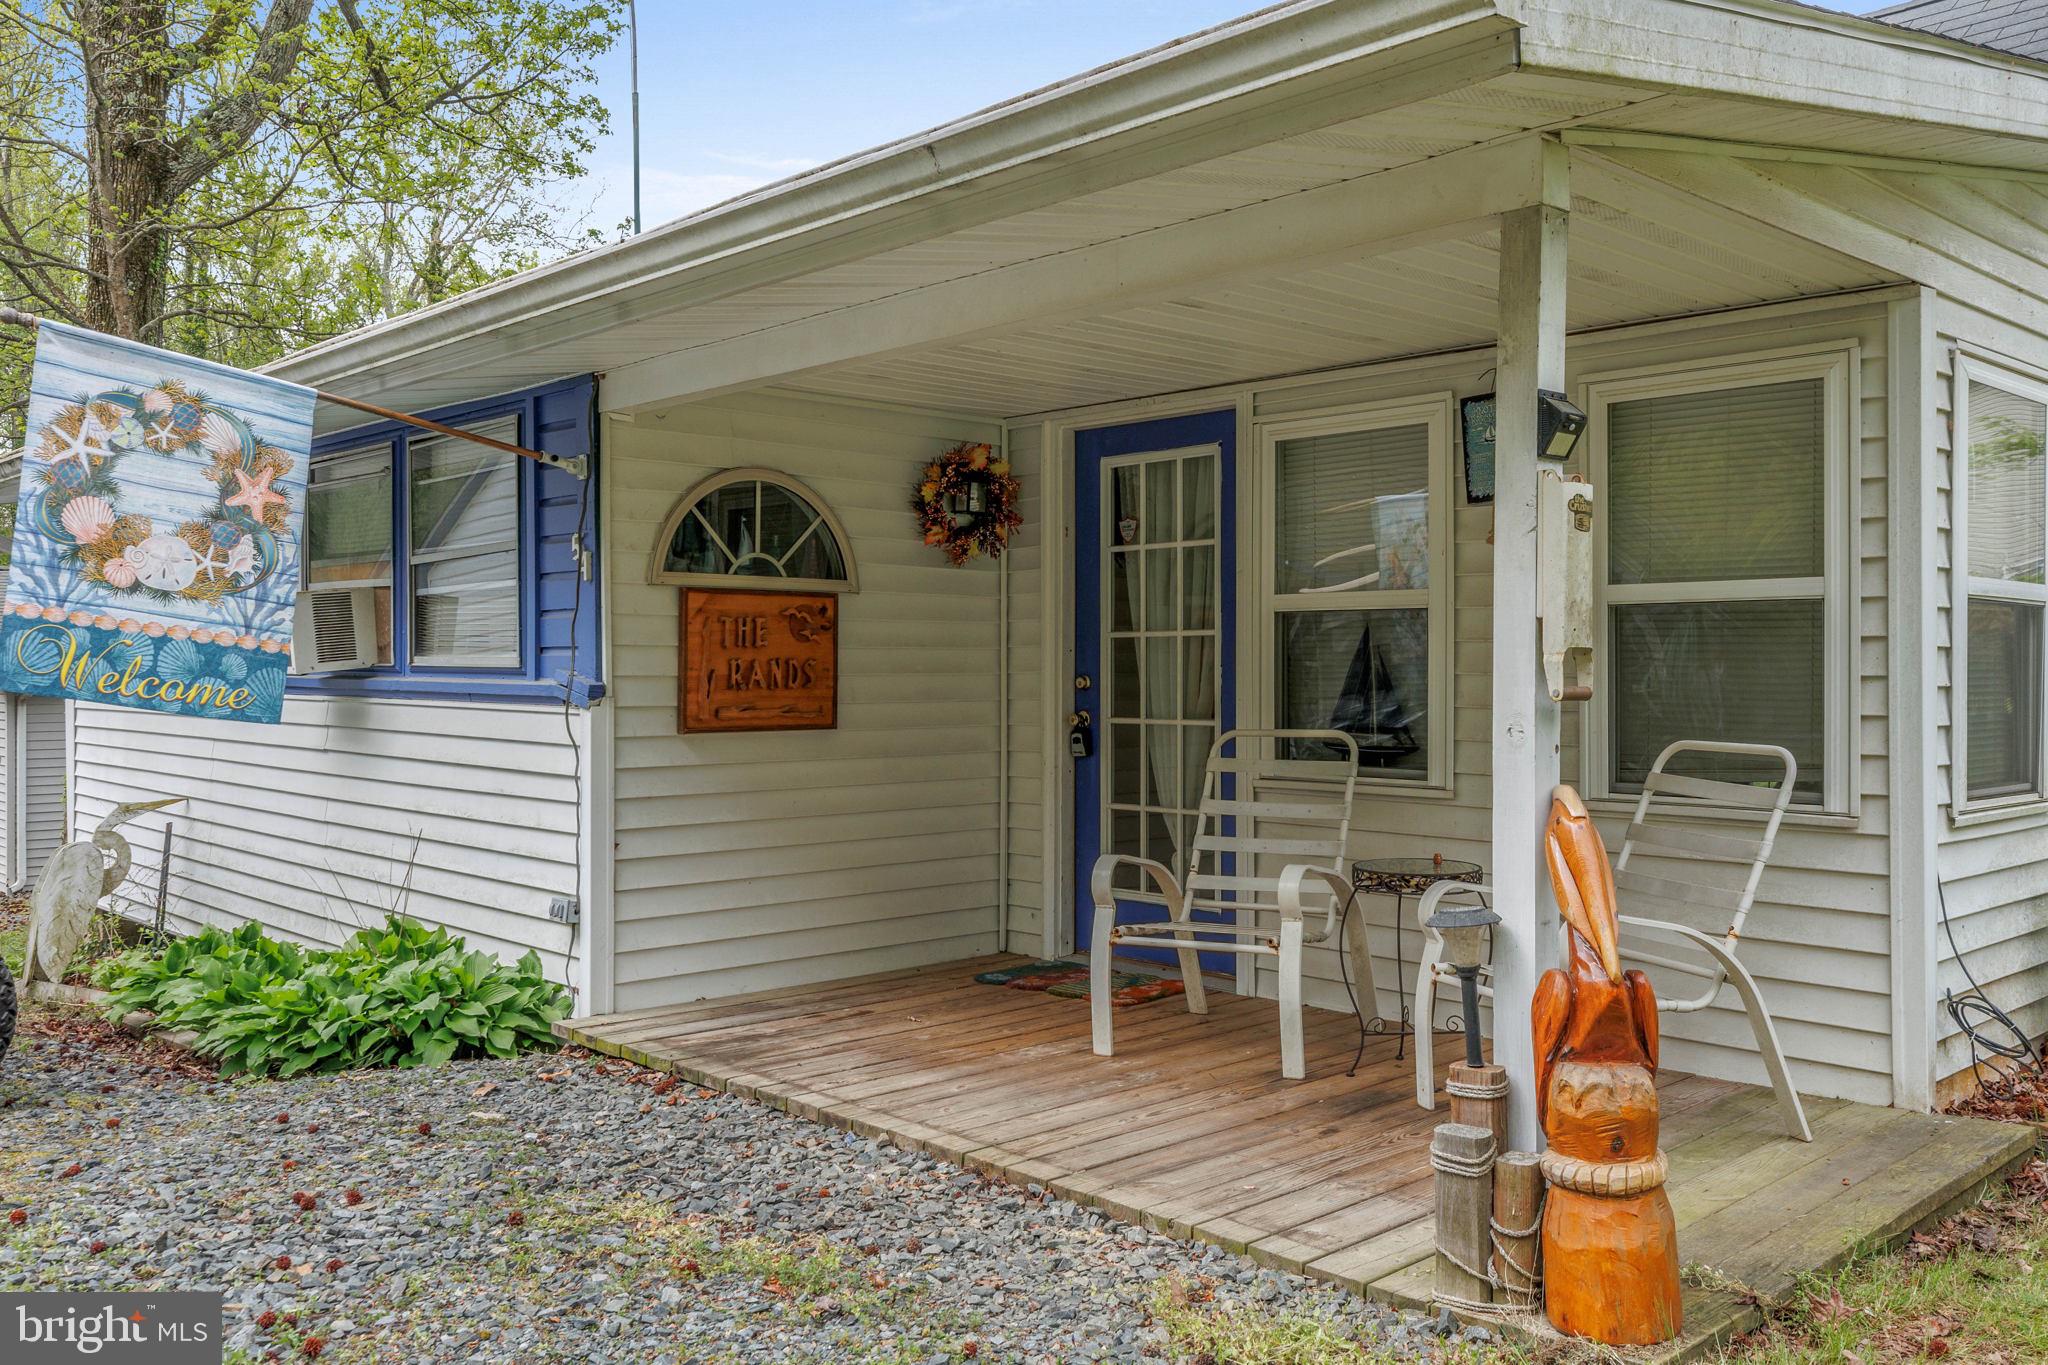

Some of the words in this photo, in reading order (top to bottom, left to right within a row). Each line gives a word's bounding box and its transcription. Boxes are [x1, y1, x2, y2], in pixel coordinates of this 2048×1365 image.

[720, 616, 768, 648] THE
[17, 624, 257, 710] Welcome
[727, 658, 816, 690] RANDS
